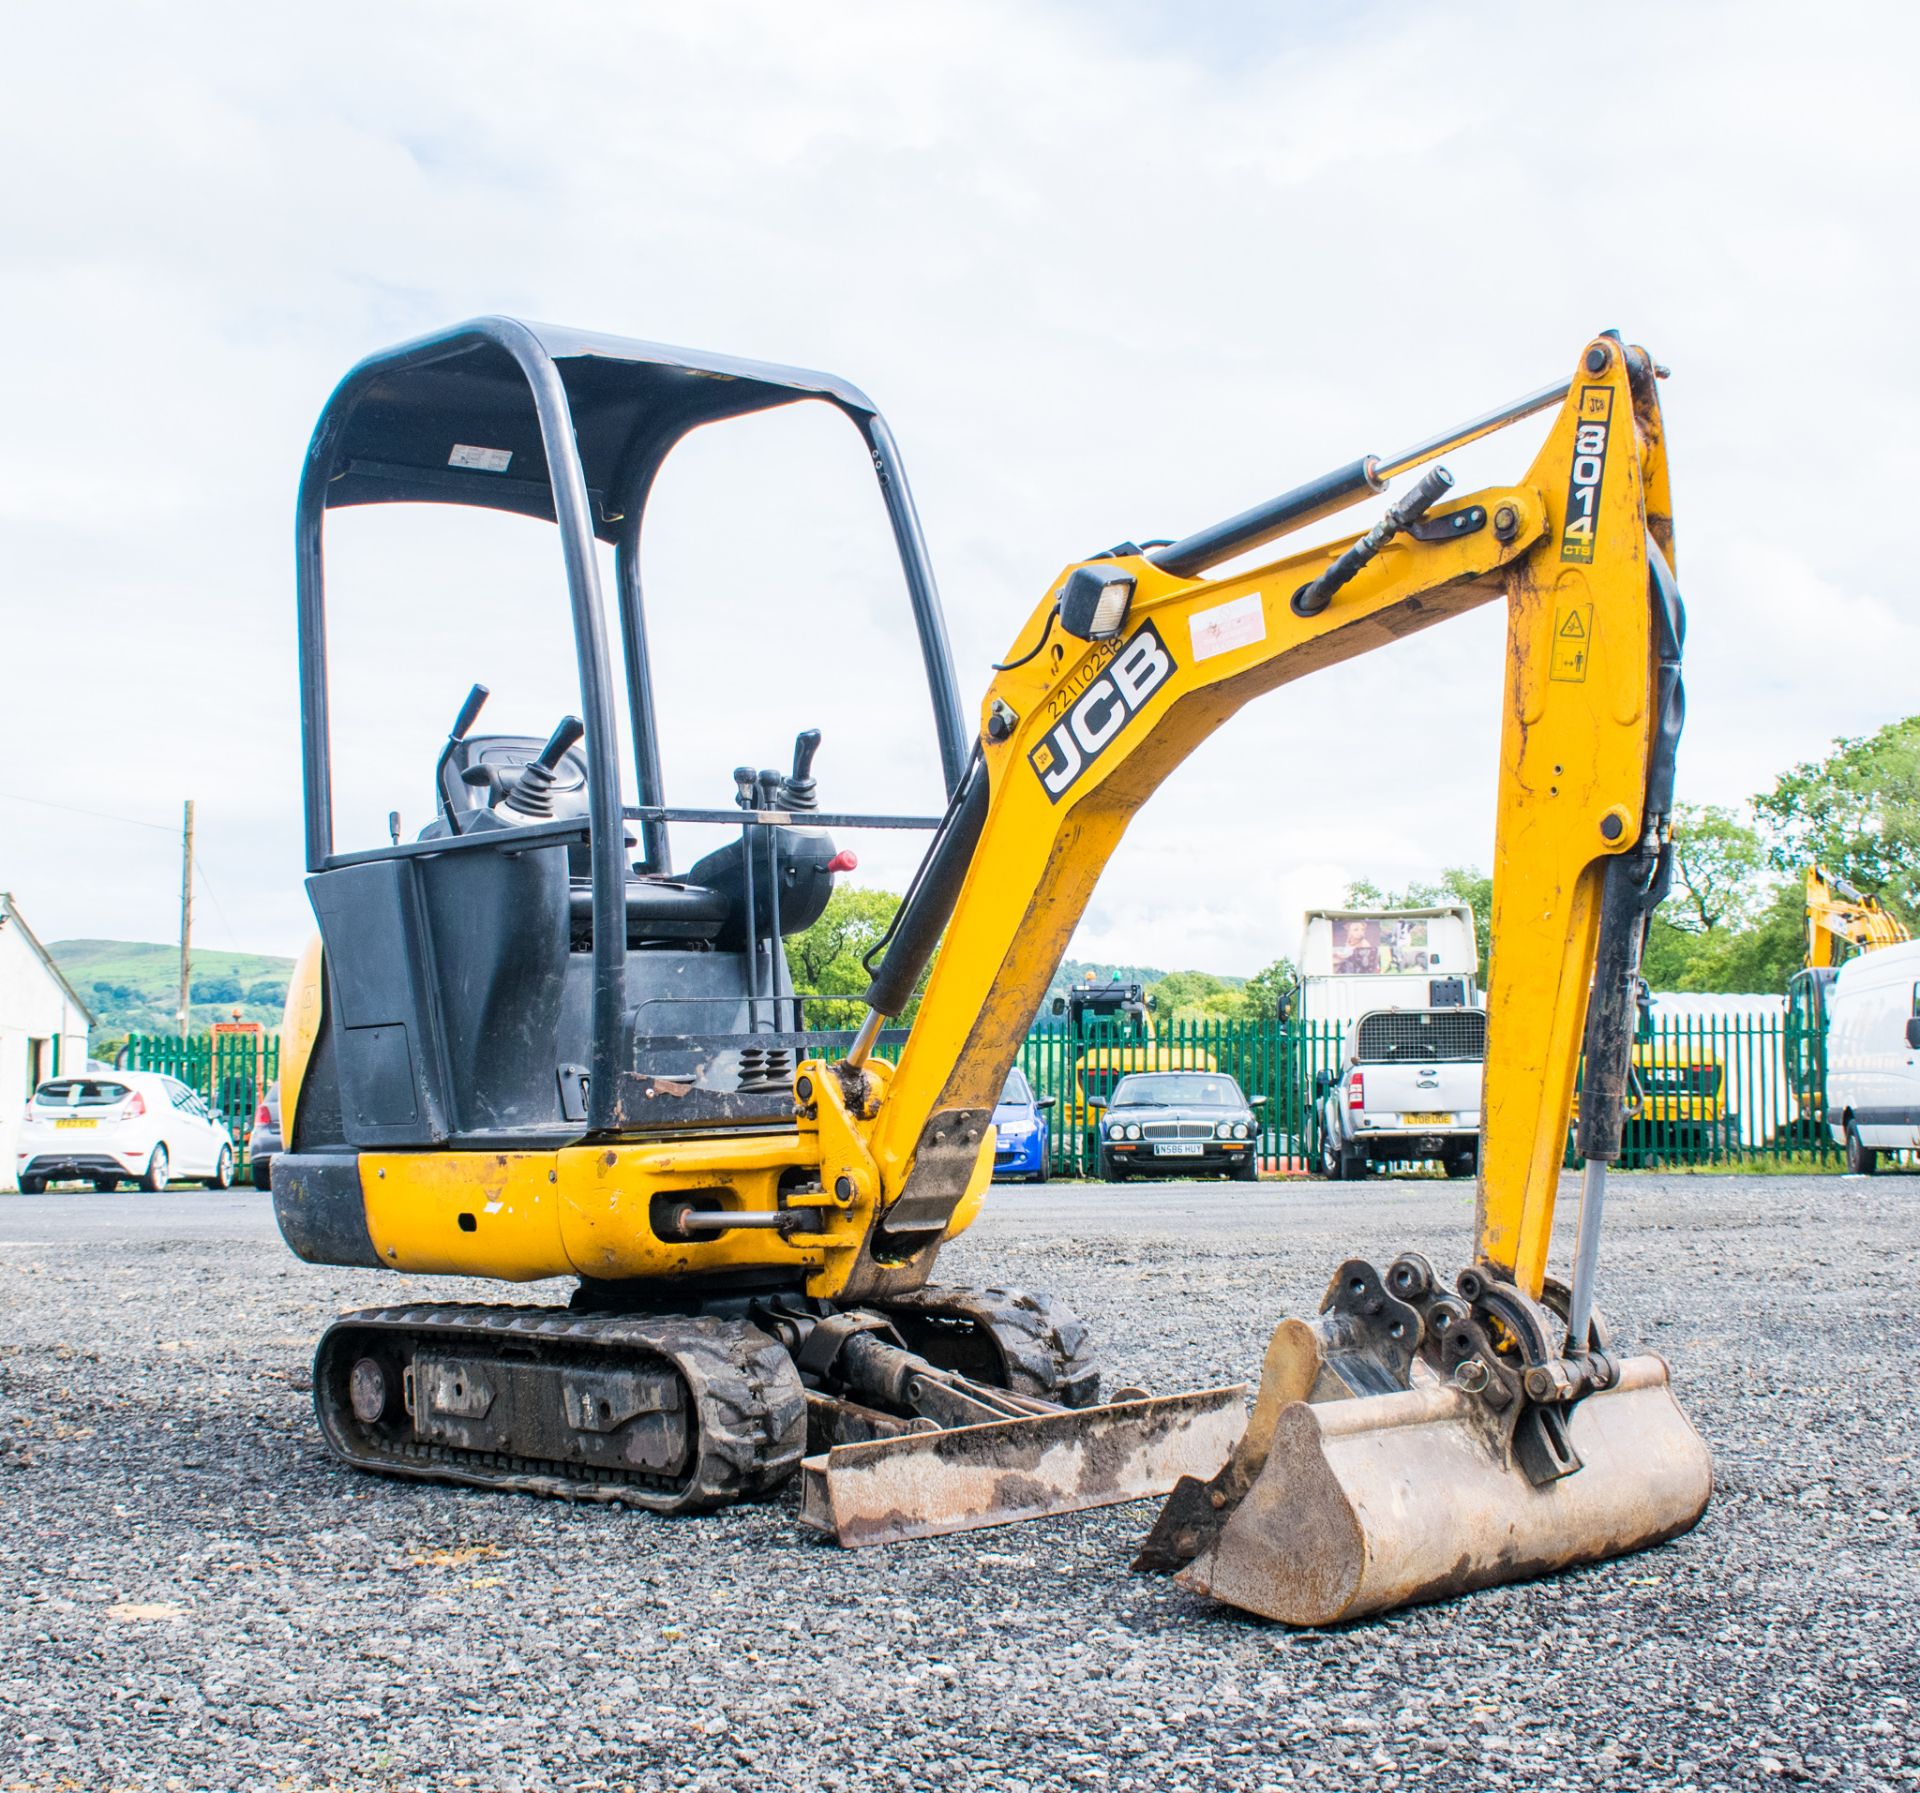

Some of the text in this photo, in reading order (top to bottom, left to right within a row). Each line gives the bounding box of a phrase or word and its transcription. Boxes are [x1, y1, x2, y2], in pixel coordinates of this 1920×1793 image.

[1565, 424, 1607, 545] 8014
[1563, 544, 1591, 556] CTS
[1044, 631, 1170, 793] JCB
[1047, 634, 1124, 720] 22110298
[1185, 1145, 1201, 1153] HUY
